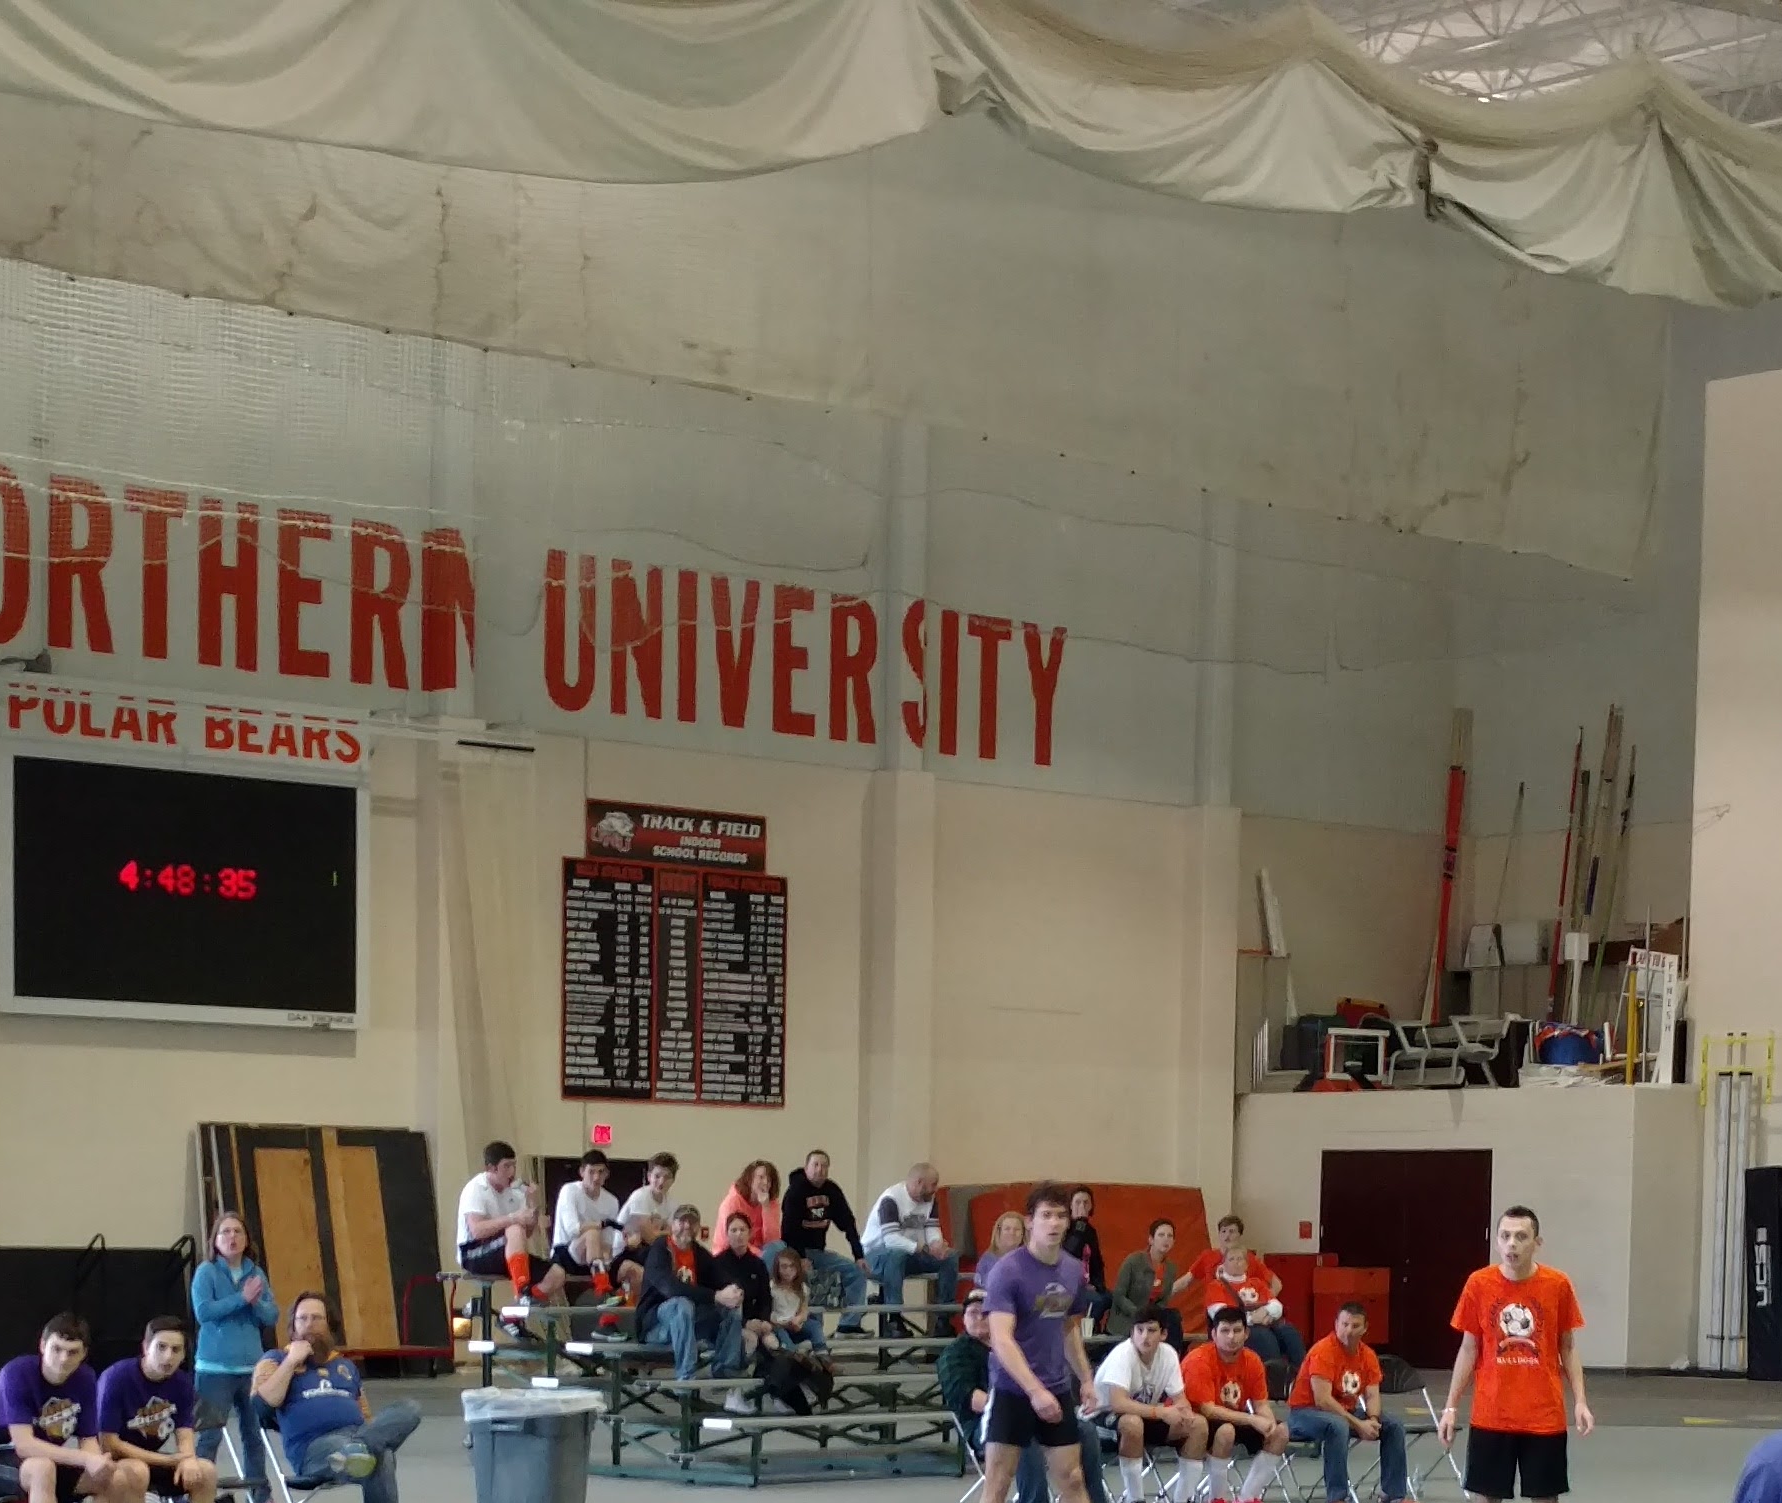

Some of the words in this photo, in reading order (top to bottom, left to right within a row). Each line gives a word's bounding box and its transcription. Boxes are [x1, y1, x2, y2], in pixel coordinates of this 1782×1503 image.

[543, 549, 1067, 766] UNIVERSITY
[8, 682, 176, 745] POLAR
[205, 705, 361, 763] BEARS
[641, 814, 695, 832] TRACK
[700, 820, 712, 834] &
[717, 821, 760, 838] FIELD
[680, 836, 721, 848] INDOOR
[653, 845, 696, 860] SCHOOL
[698, 850, 748, 864] RECORDS
